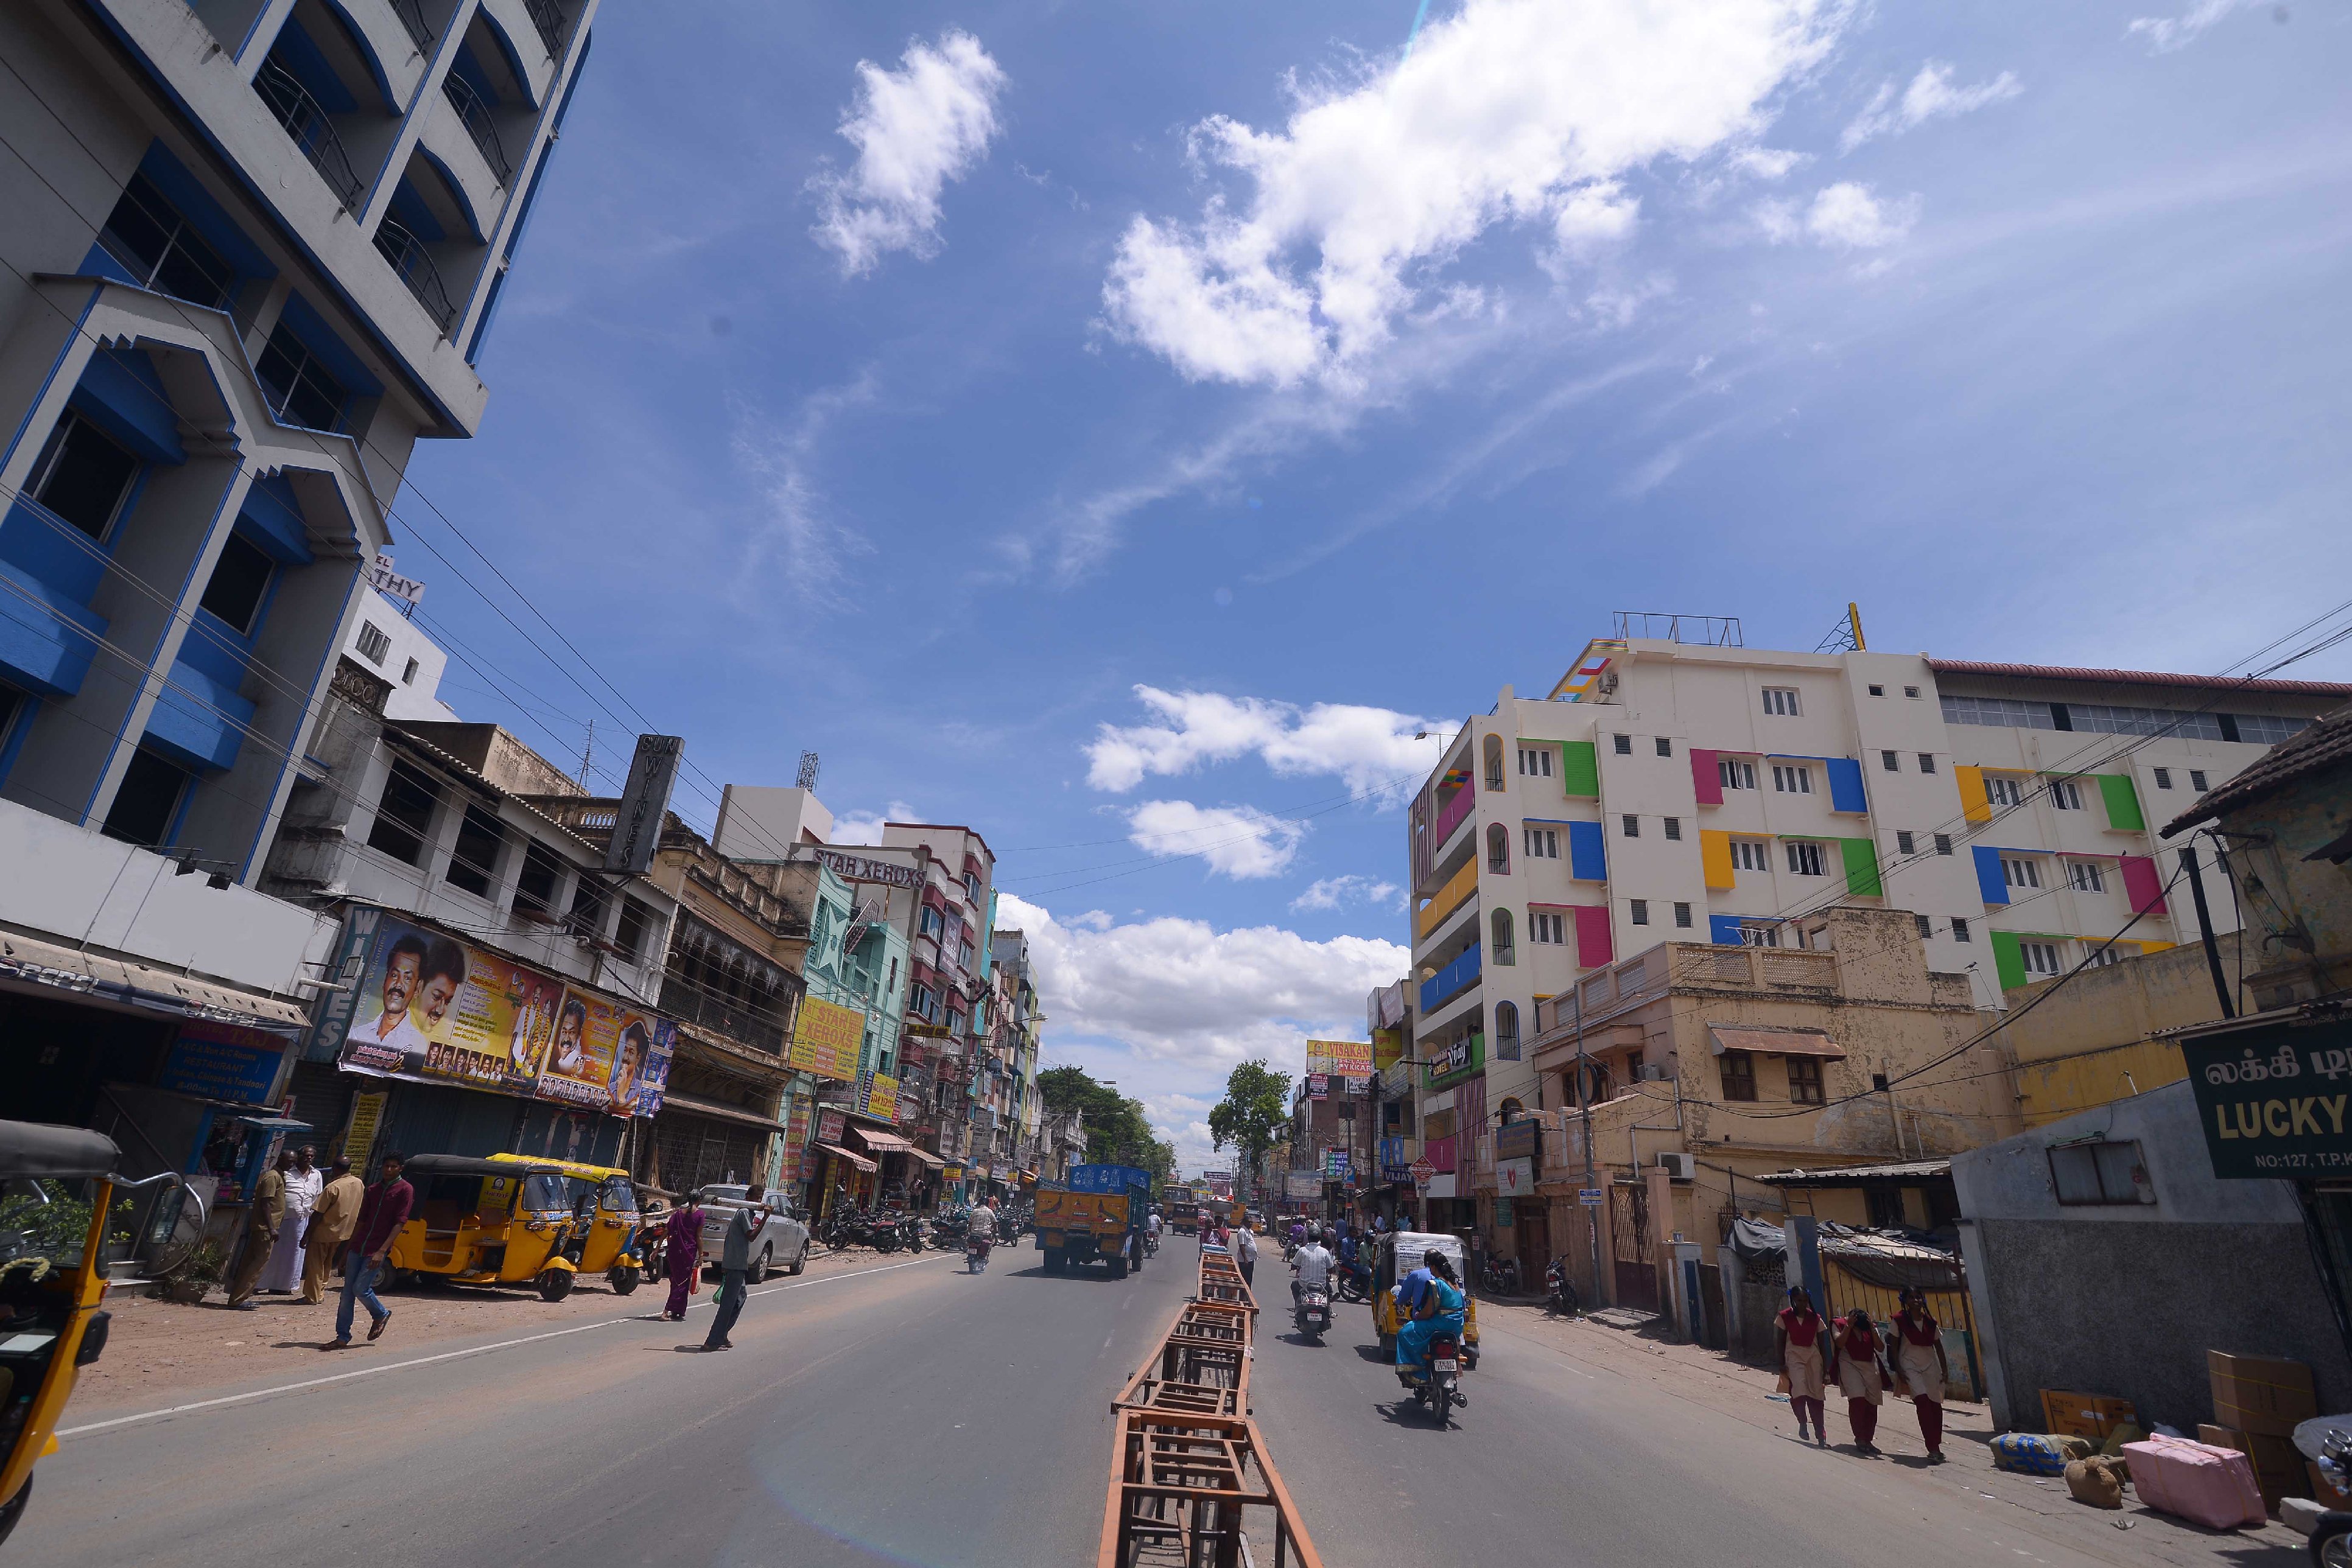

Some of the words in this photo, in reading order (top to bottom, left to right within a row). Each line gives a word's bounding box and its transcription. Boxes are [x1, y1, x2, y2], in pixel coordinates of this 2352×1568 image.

[369, 568, 421, 597] THY
[641, 736, 677, 755] SUN
[620, 755, 662, 867] WINES
[814, 850, 857, 875] STAR
[862, 859, 925, 887] XEROXS
[18, 964, 99, 994] PEPSI
[818, 1006, 849, 1029] STAR
[189, 1022, 225, 1034] HOTEL
[231, 1027, 269, 1048] TAJ
[805, 1020, 854, 1049] XEROXS
[233, 1051, 258, 1062] Rooms
[1329, 1043, 1369, 1058] VISAKAN
[1448, 1043, 1466, 1066] Vijay
[183, 1056, 246, 1073] RESTAURANT
[1433, 1062, 1448, 1076] HOTEL
[2205, 1045, 2300, 1085] லக்கி
[197, 1071, 226, 1083] Chinese
[234, 1076, 267, 1090] Tandoori
[871, 1094, 881, 1105] STAR
[2216, 1094, 2347, 1139] LUCKY
[828, 1125, 843, 1135] LODGE
[2255, 1153, 2314, 1169] NO:127,
[803, 1167, 813, 1178] 300
[1385, 1171, 1413, 1182] VIJAY
